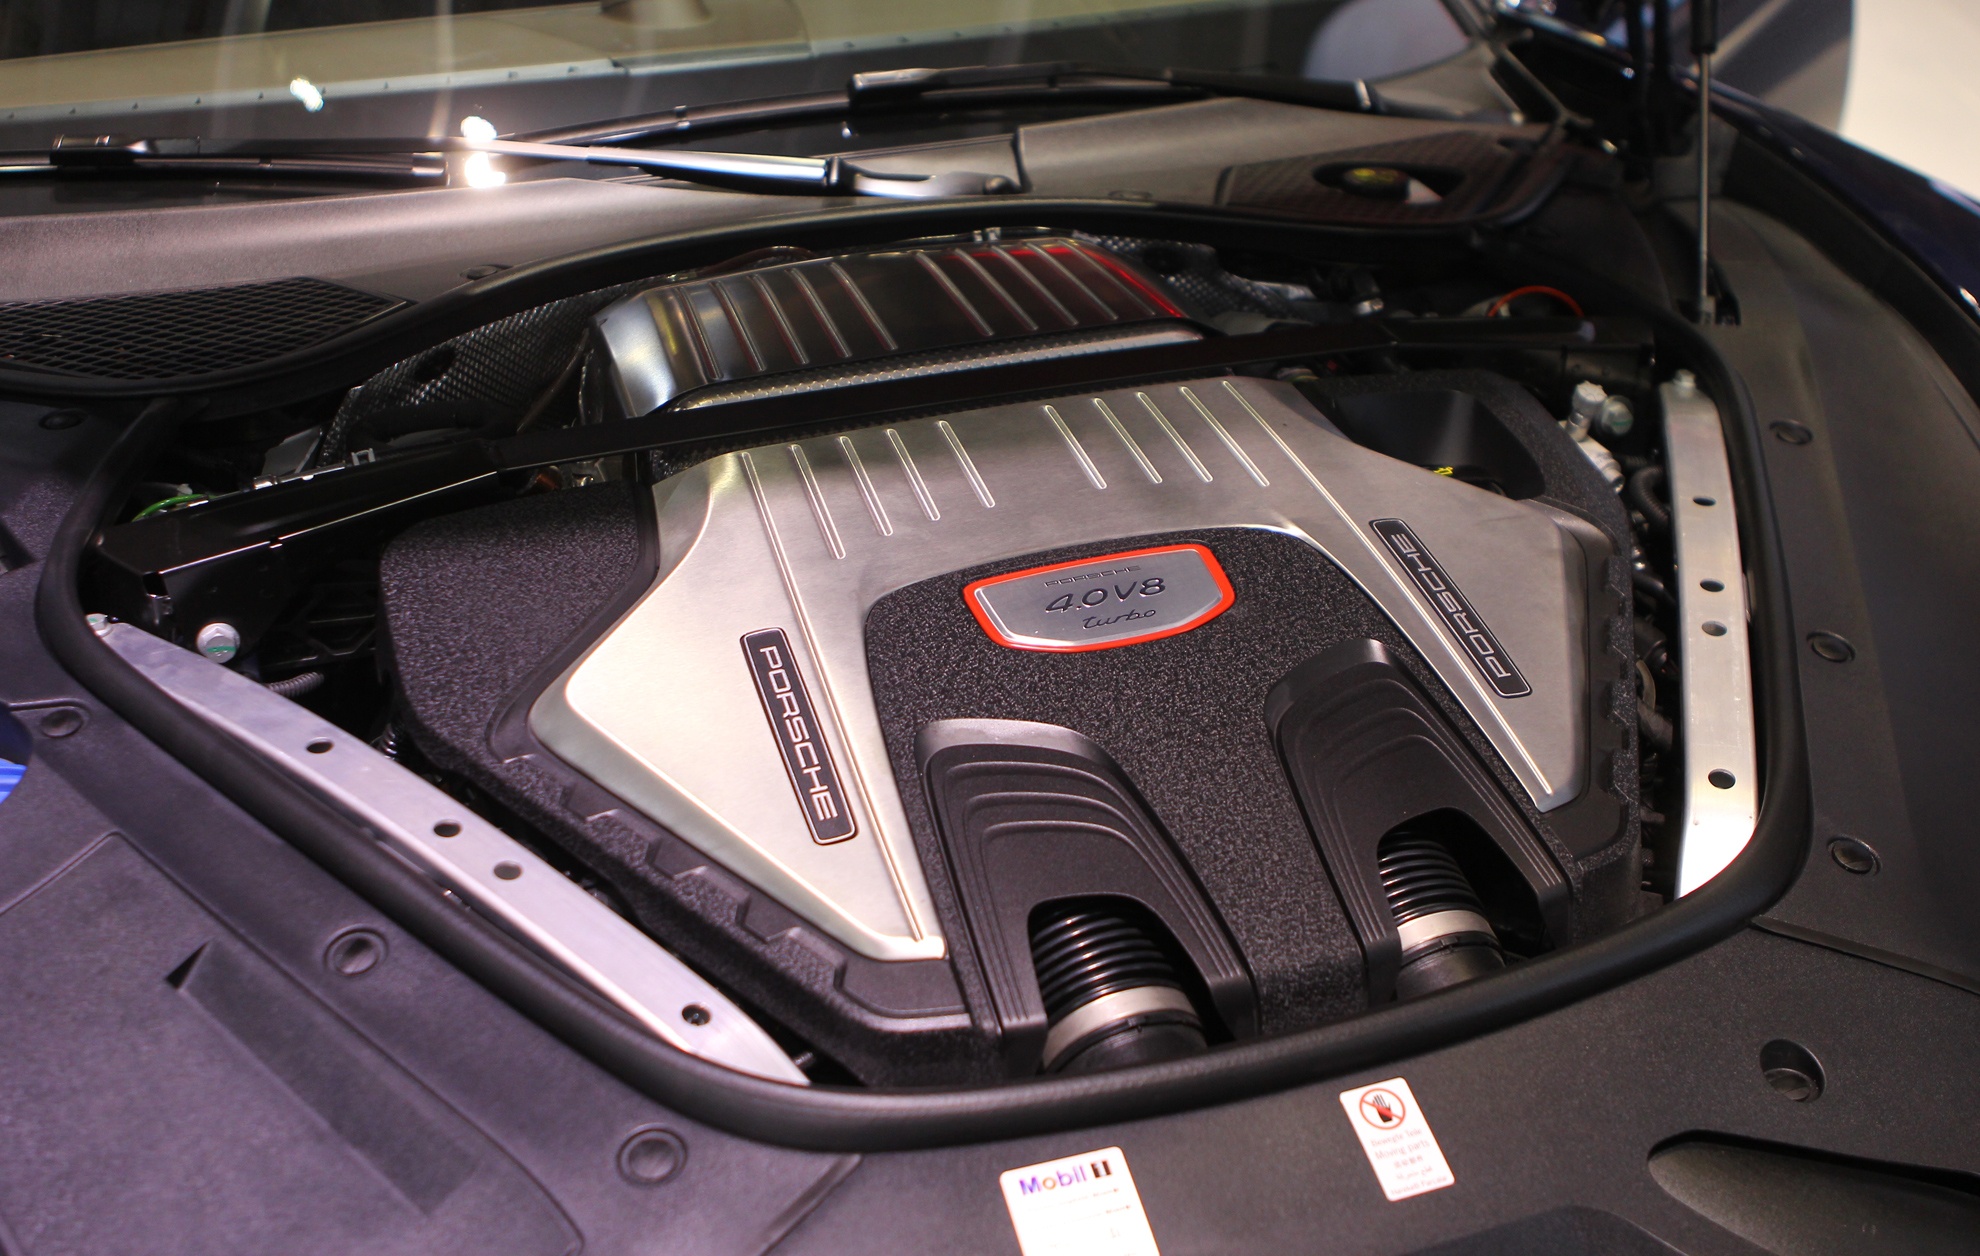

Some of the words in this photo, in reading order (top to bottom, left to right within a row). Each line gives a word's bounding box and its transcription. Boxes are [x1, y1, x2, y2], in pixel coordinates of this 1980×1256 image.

[1044, 565, 1141, 587] PORSCHE
[1082, 608, 1157, 630] turbo
[1391, 533, 1512, 678] PORSCHE
[759, 645, 839, 821] PORSCHE
[1018, 1164, 1088, 1196] Mobil
